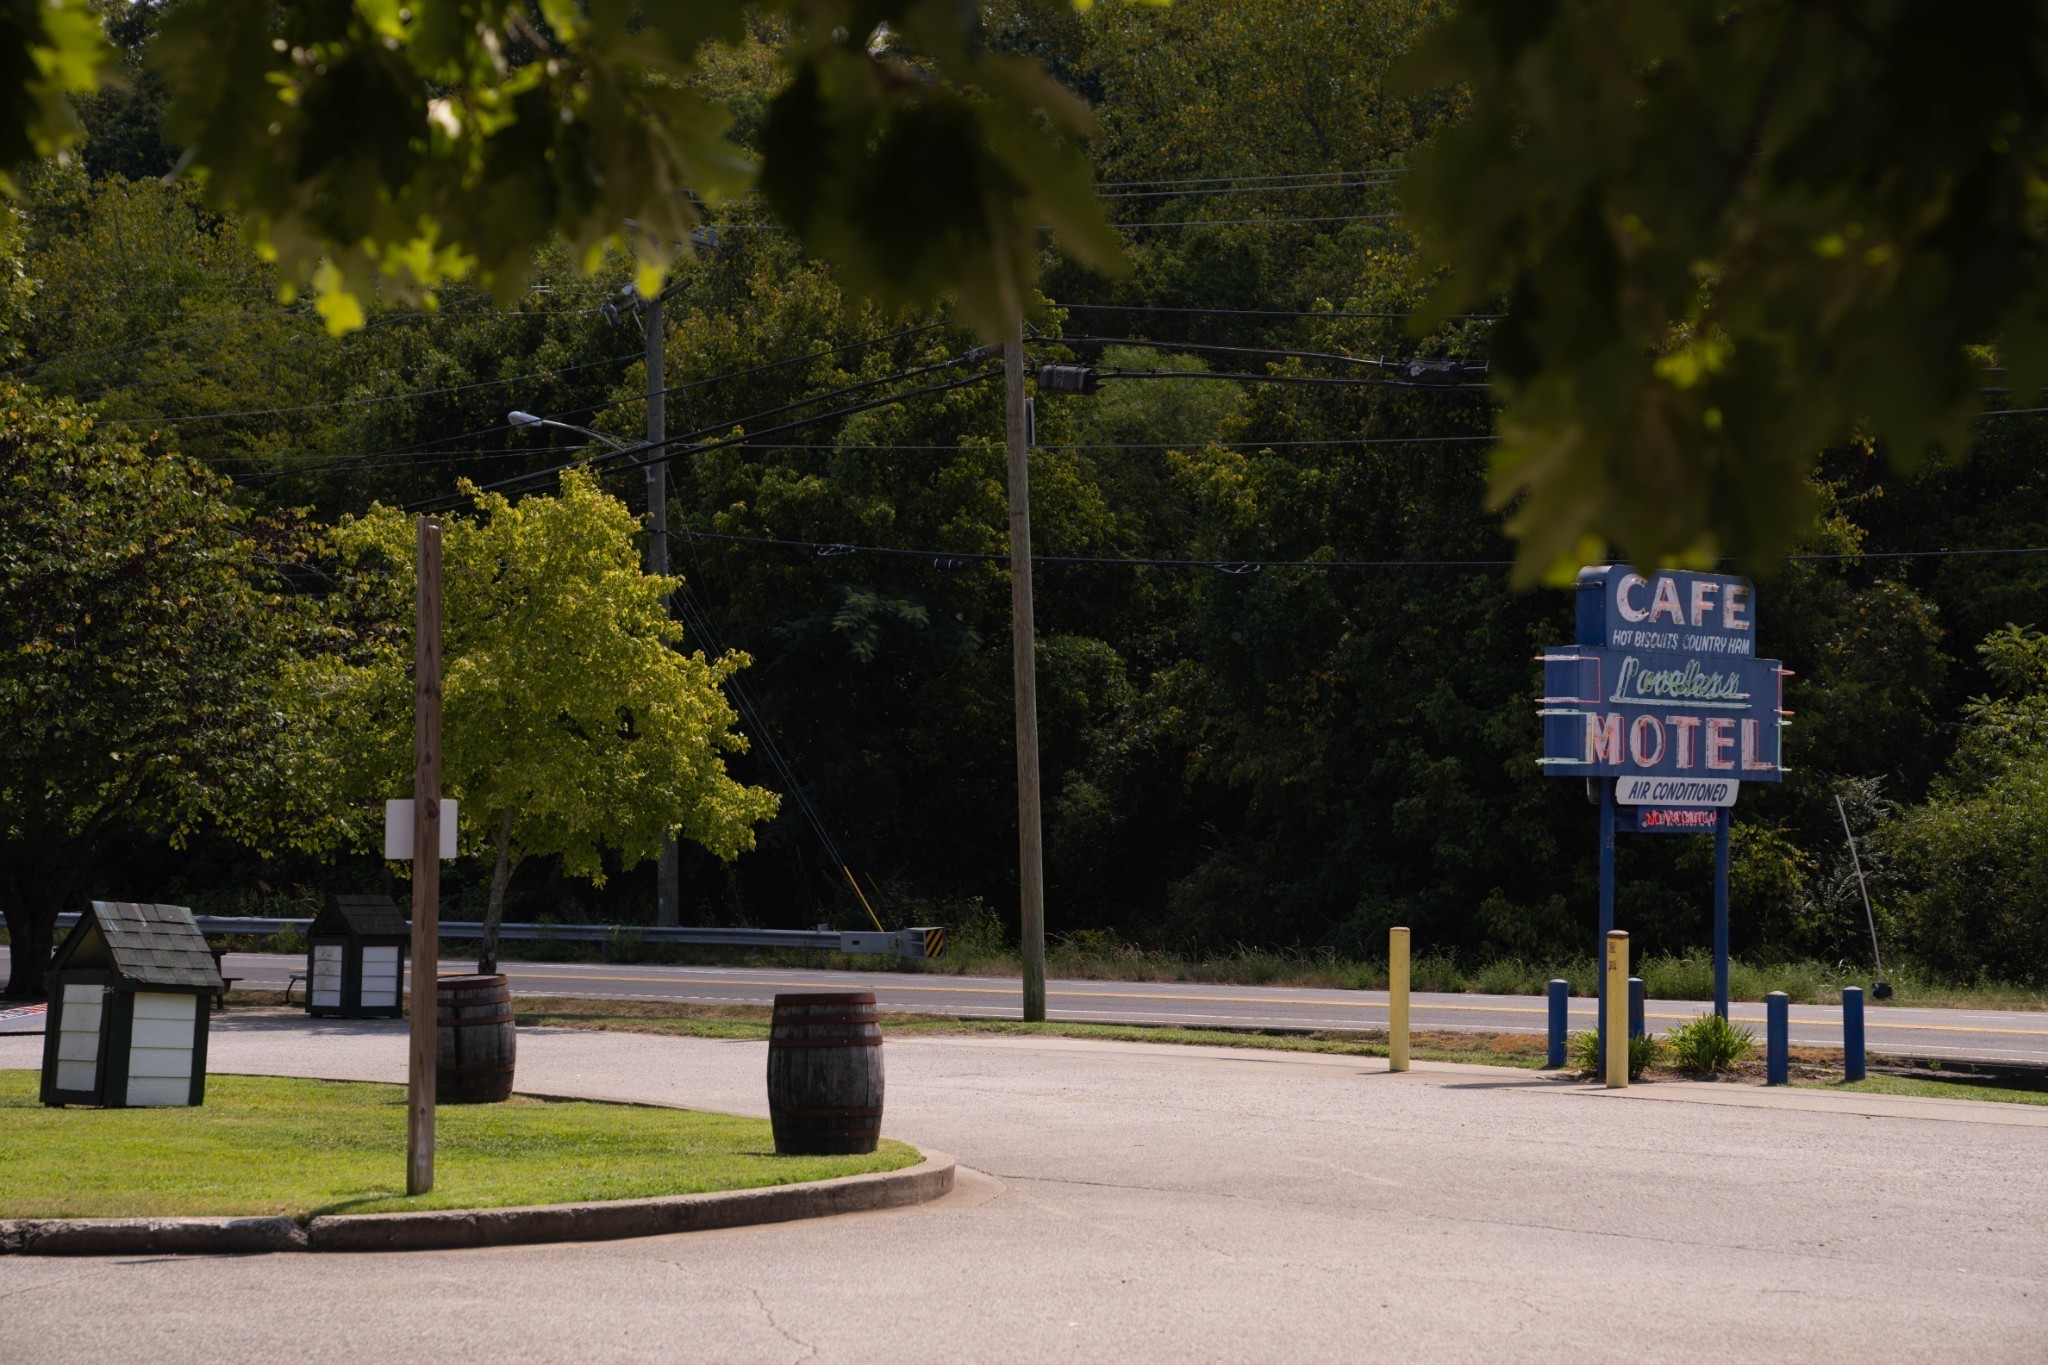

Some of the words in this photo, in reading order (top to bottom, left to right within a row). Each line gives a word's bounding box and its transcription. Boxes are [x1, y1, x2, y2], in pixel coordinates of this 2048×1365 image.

[1616, 573, 1750, 631] CAFE
[1612, 629, 1634, 646] HOT
[1634, 631, 1679, 650] BISCUITS
[1683, 634, 1728, 653] COUNTRY
[1727, 637, 1751, 655] HAM
[1610, 655, 1746, 704] Loveless
[1585, 711, 1773, 771] MOTEL
[1628, 780, 1651, 800] AIR
[1653, 781, 1728, 802] CONDITIONED
